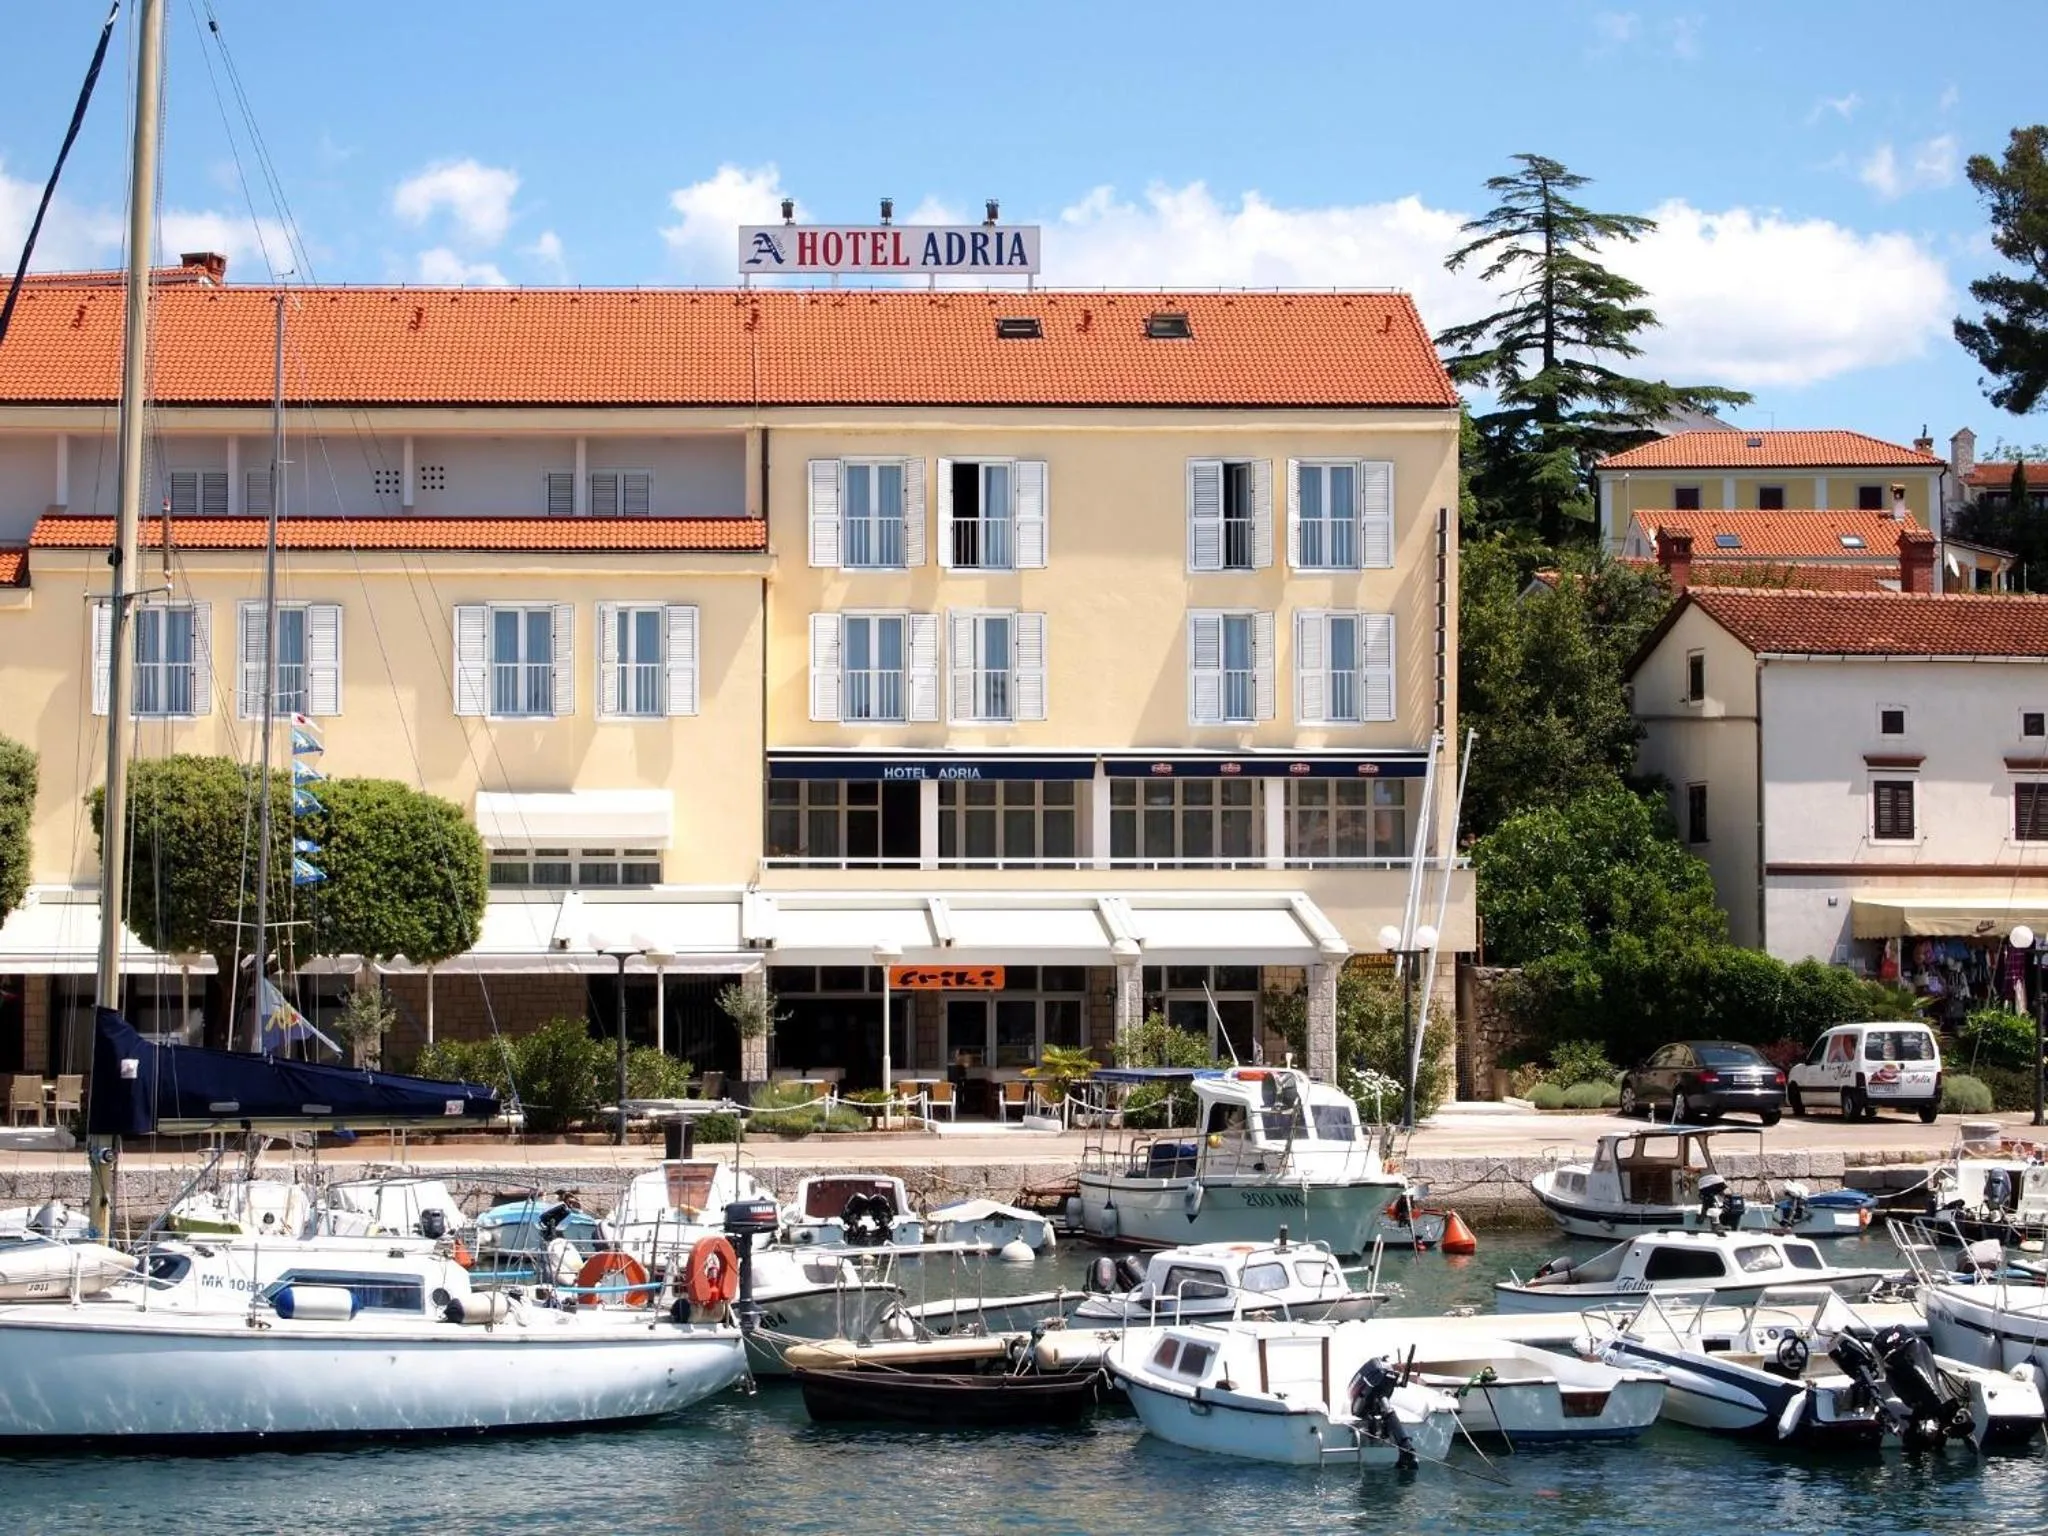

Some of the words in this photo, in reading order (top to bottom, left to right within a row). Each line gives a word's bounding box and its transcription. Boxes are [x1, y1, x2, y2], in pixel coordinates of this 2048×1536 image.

[797, 231, 910, 266] HOTEL
[921, 231, 1028, 266] ADRIA
[884, 766, 929, 779] HOTEL
[938, 766, 981, 779] ADRIA
[1241, 1191, 1275, 1208] 200
[1275, 1192, 1304, 1208] MK
[201, 1273, 224, 1289] MK
